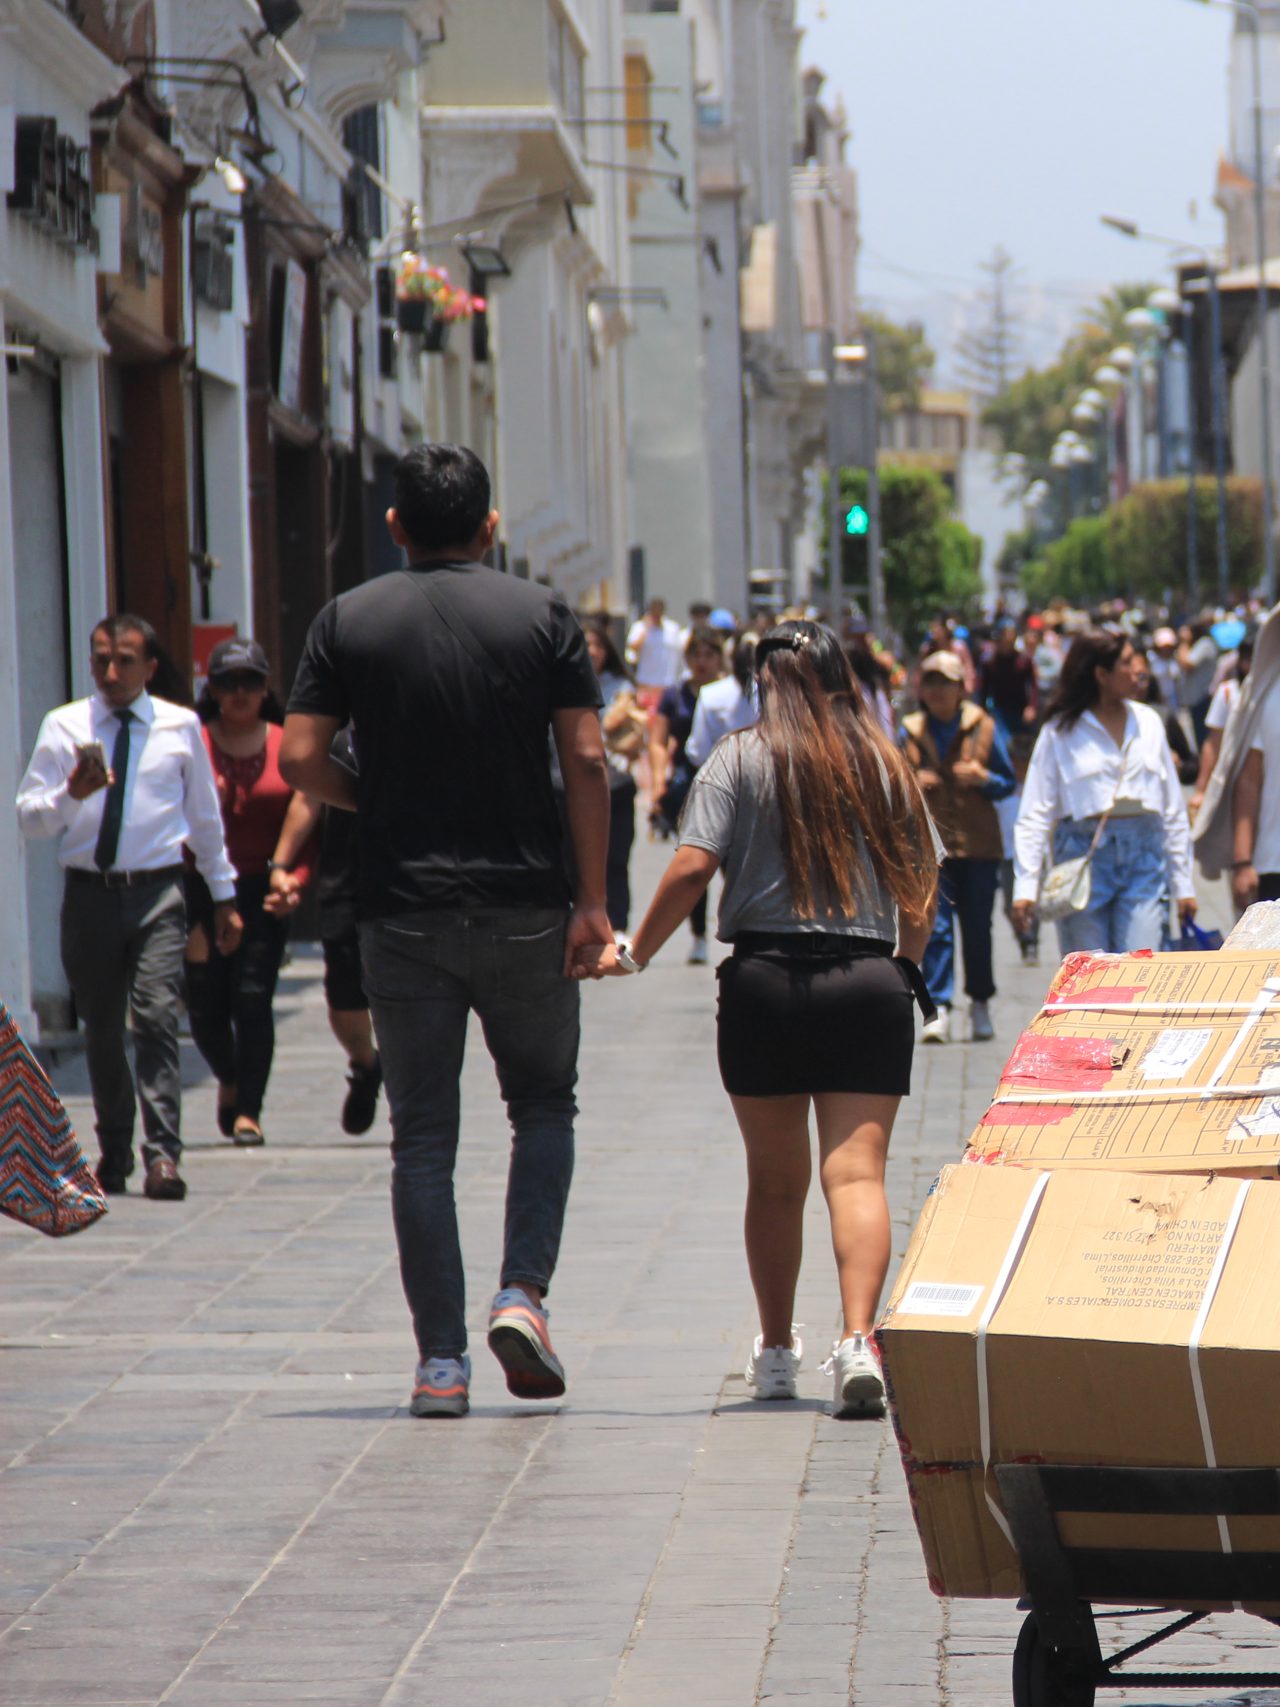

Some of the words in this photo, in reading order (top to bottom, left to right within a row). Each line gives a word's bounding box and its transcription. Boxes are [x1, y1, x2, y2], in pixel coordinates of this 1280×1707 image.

[1186, 1233, 1223, 1243] ARTON
[1166, 1243, 1219, 1254] IMA-PERU
[1105, 1287, 1154, 1297] CENTRAL
[1065, 1296, 1142, 1307] COMERCIALES
